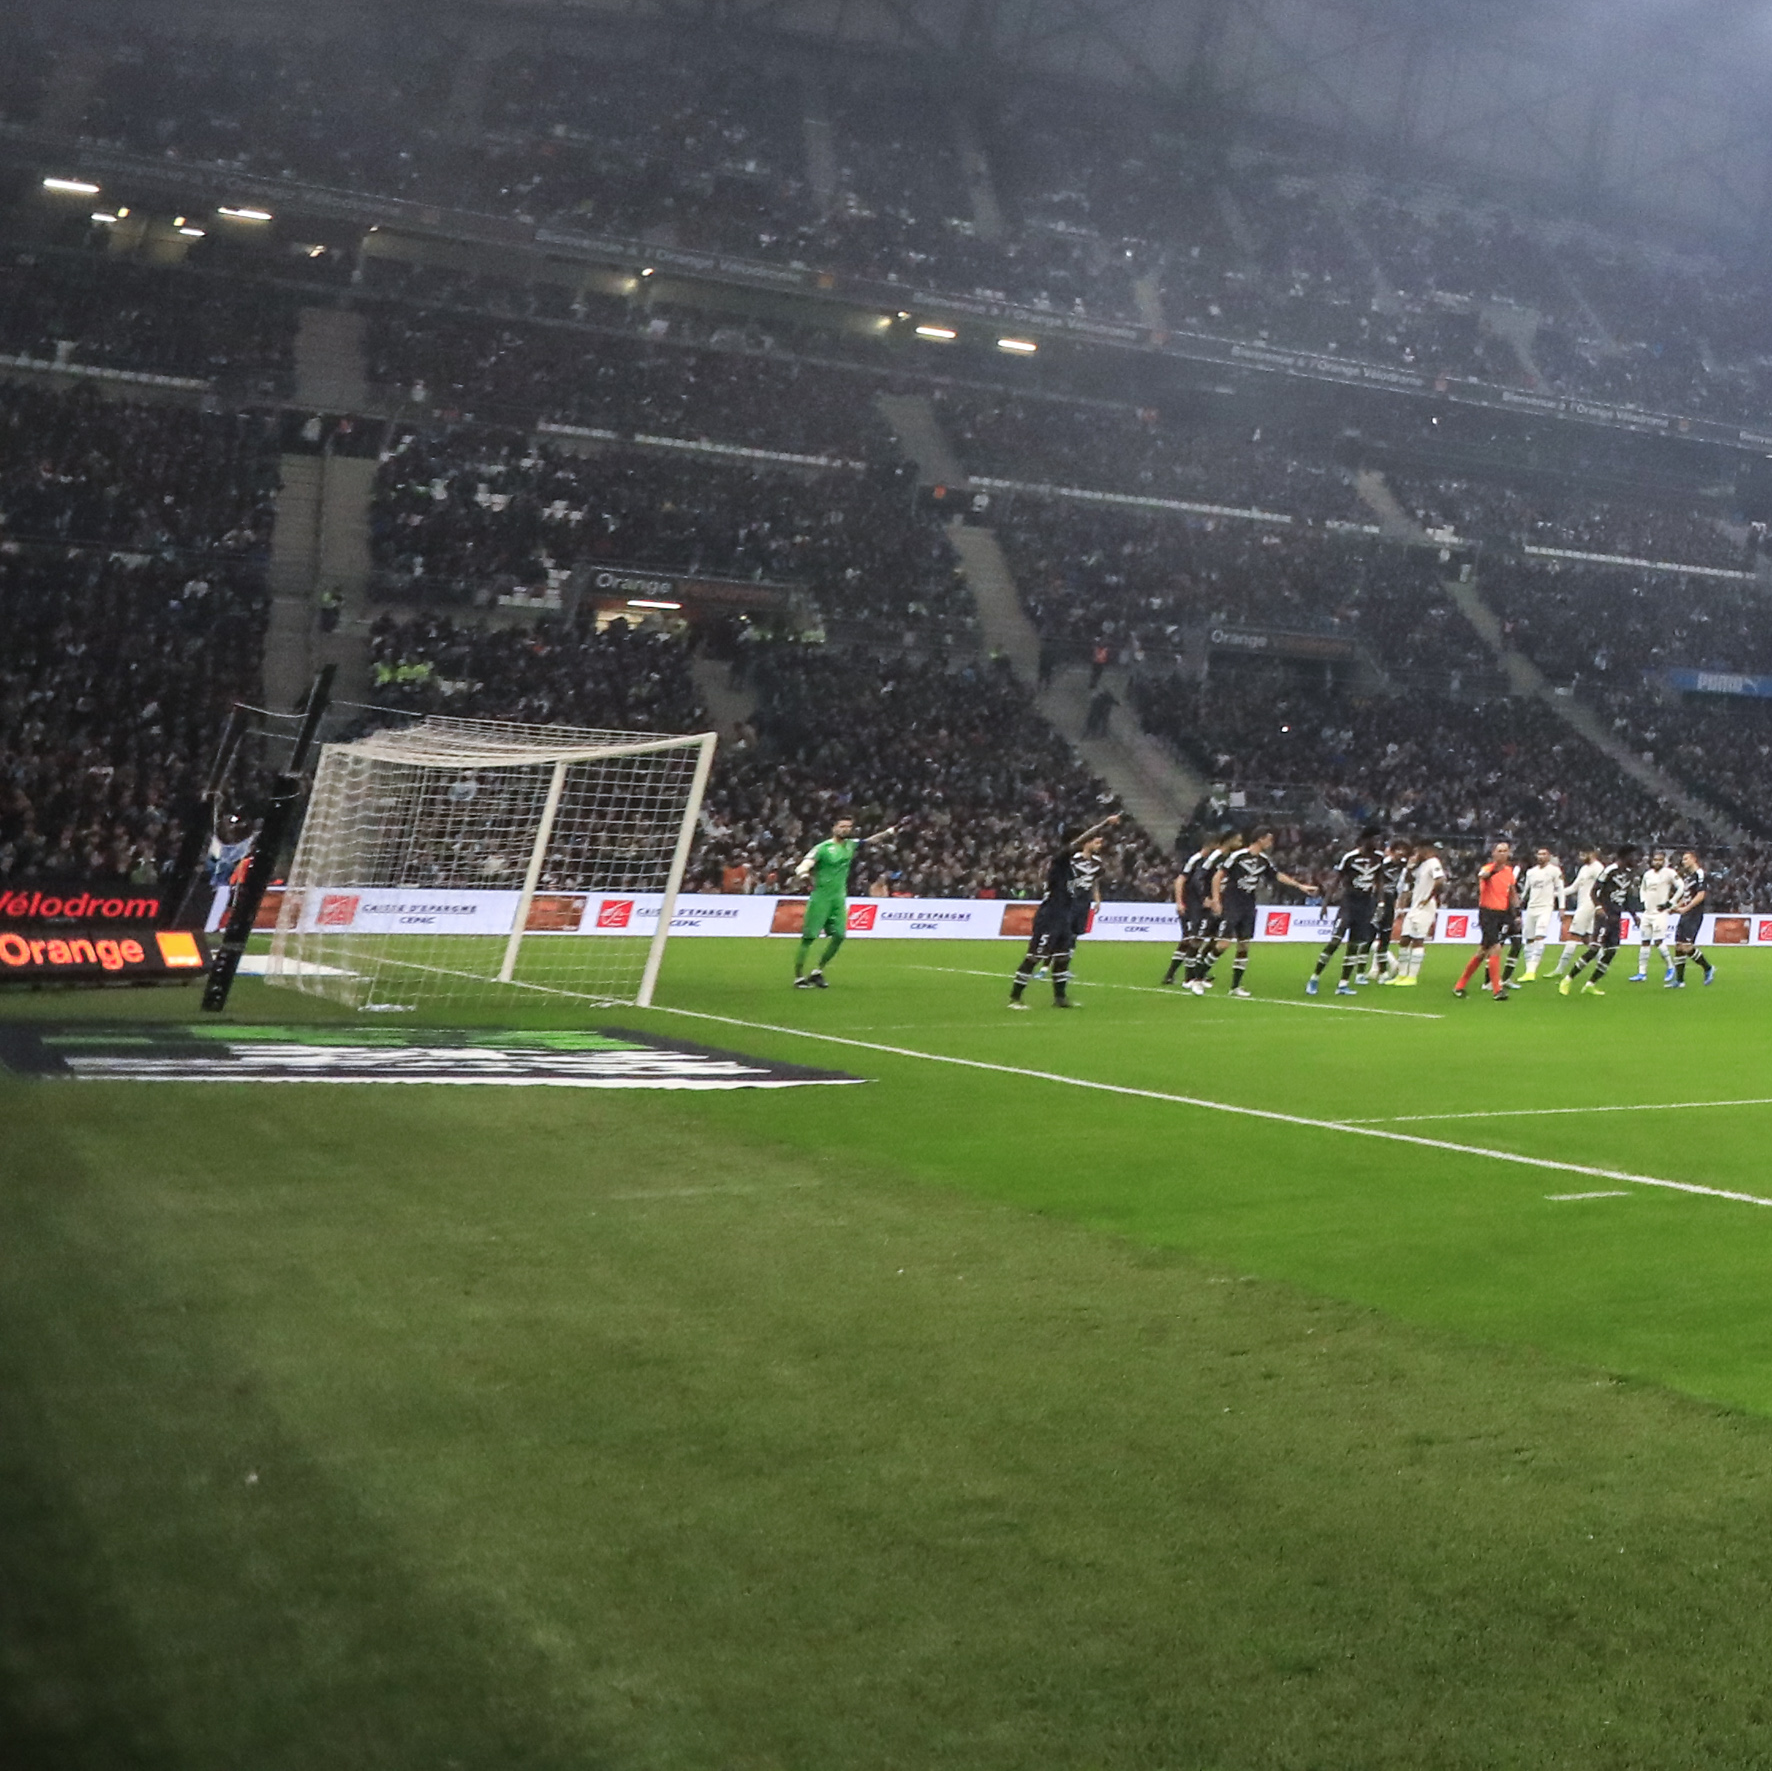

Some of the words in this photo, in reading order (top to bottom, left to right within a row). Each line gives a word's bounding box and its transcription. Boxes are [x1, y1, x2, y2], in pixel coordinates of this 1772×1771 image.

[596, 572, 672, 595] Orange
[1211, 629, 1268, 649] Orange
[637, 908, 664, 917] CAIS
[880, 912, 914, 920] CAISSE
[1098, 915, 1129, 923] CAISSE
[1199, 918, 1208, 930] 3
[1038, 933, 1050, 946] 5
[0, 932, 145, 970] Orange
